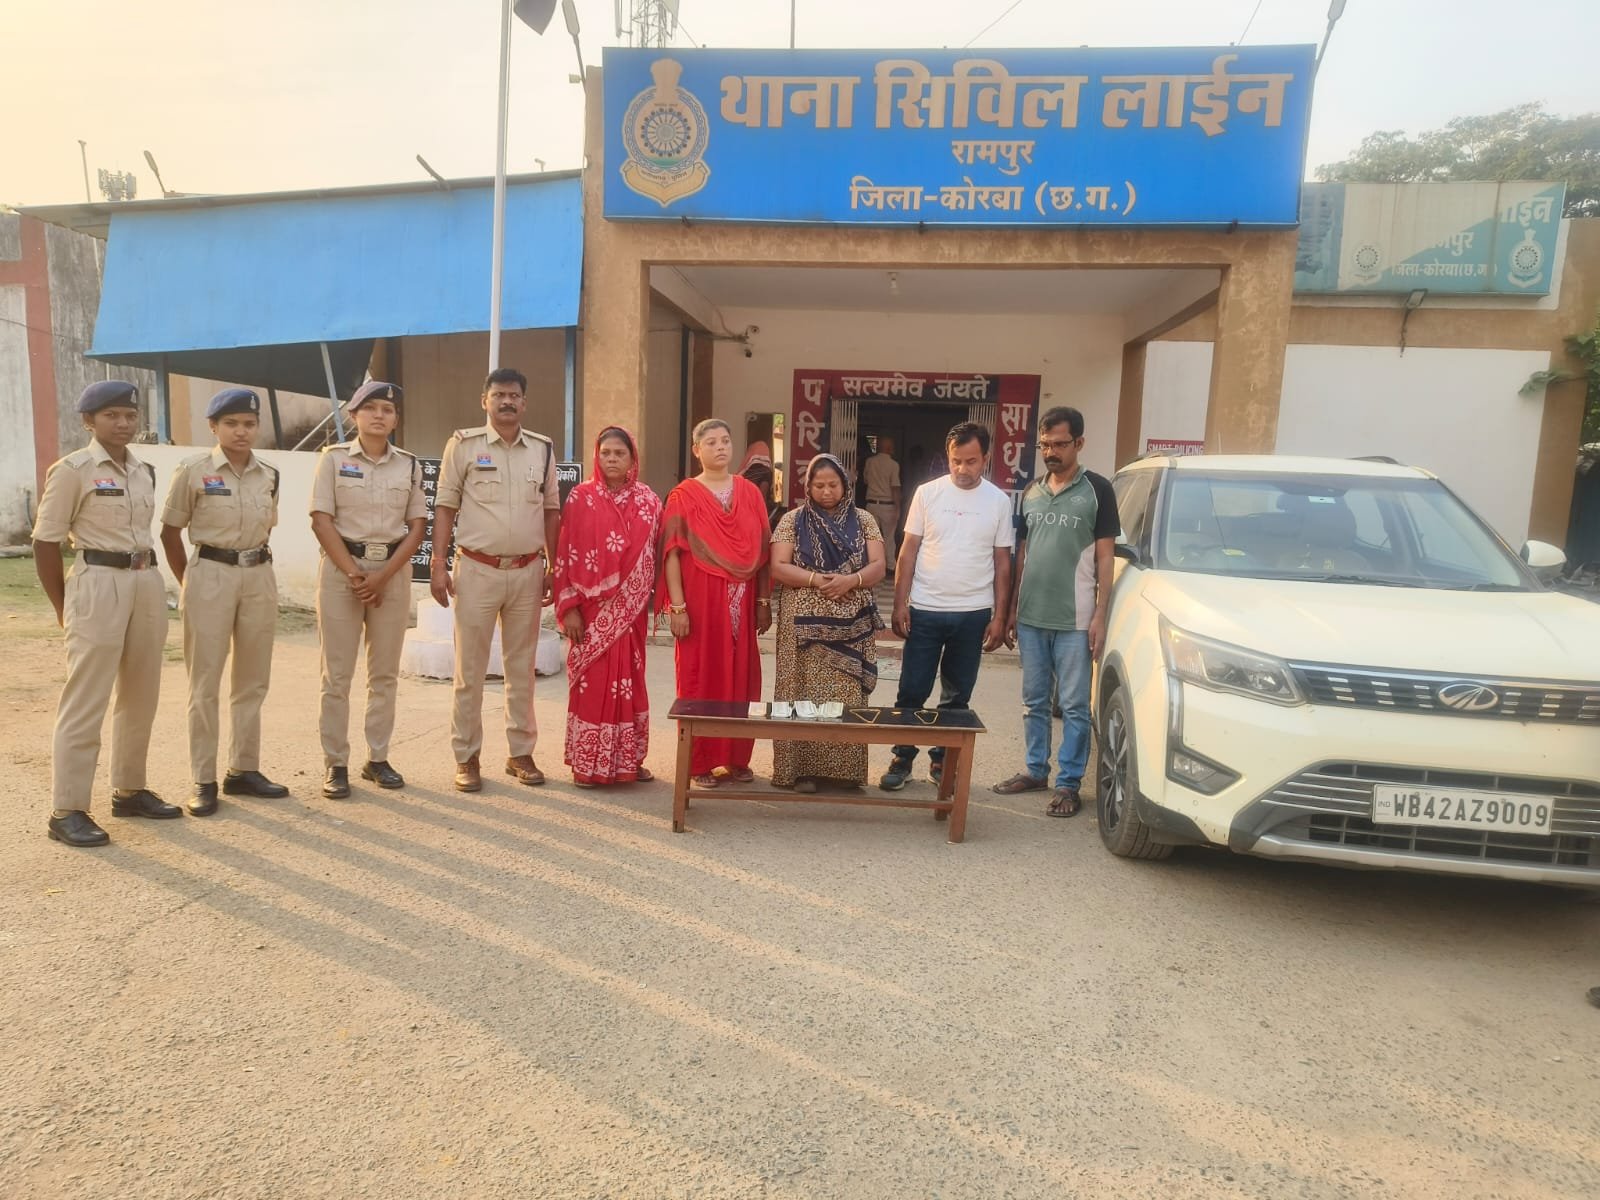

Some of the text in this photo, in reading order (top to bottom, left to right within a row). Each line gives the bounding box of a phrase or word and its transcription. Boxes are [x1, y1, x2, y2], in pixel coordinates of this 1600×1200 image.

[720, 53, 1294, 137] थाना सिविल लाईन
[951, 140, 1036, 176] रामपुर
[849, 175, 1137, 216] जिला-कोरबा (छ.ग.)
[841, 372, 991, 399] सत्यमेव जयते
[1026, 511, 1082, 530] SPORT
[1393, 793, 1549, 828] WB42AZ9009
